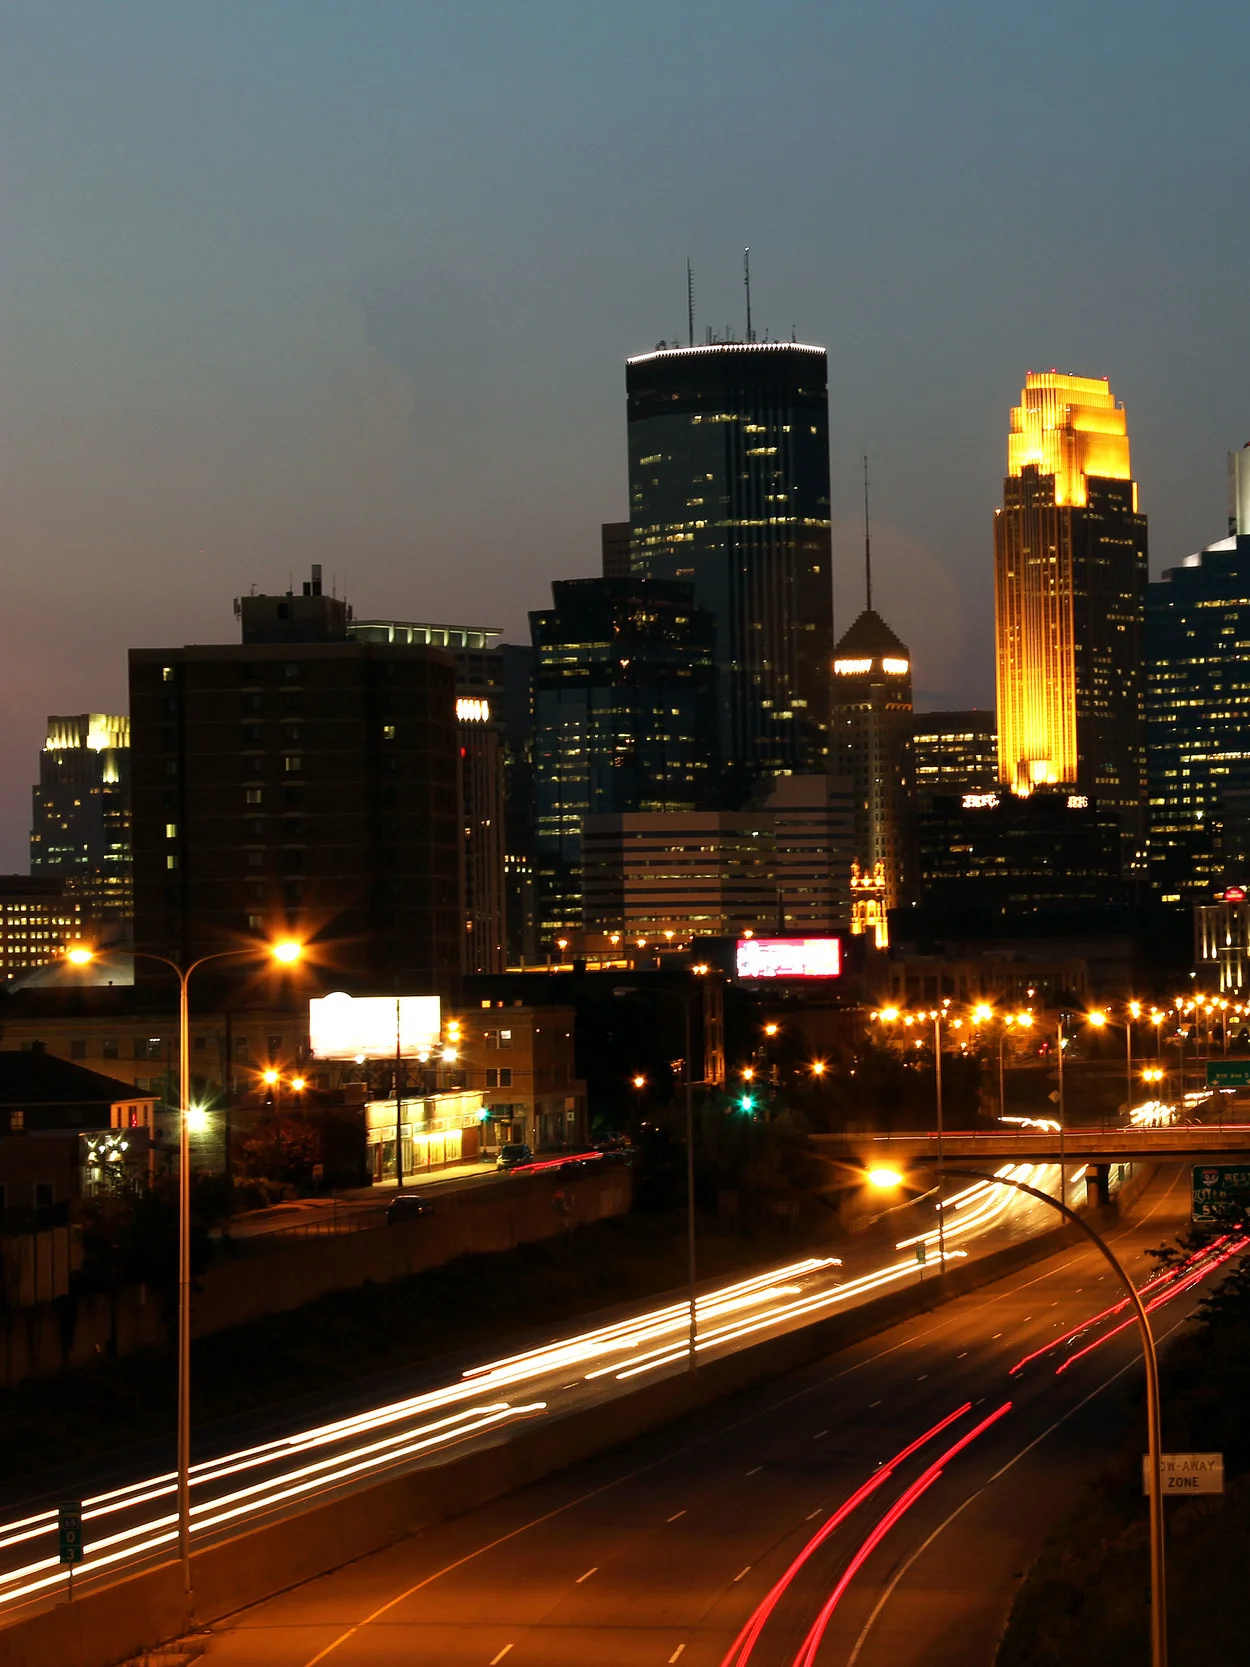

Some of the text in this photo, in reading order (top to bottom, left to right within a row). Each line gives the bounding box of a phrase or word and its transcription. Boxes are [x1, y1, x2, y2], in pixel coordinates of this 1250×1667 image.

[1160, 1460, 1215, 1472] OW-AWAY
[1168, 1477, 1199, 1488] ZONE
[67, 1548, 75, 1560] 3
